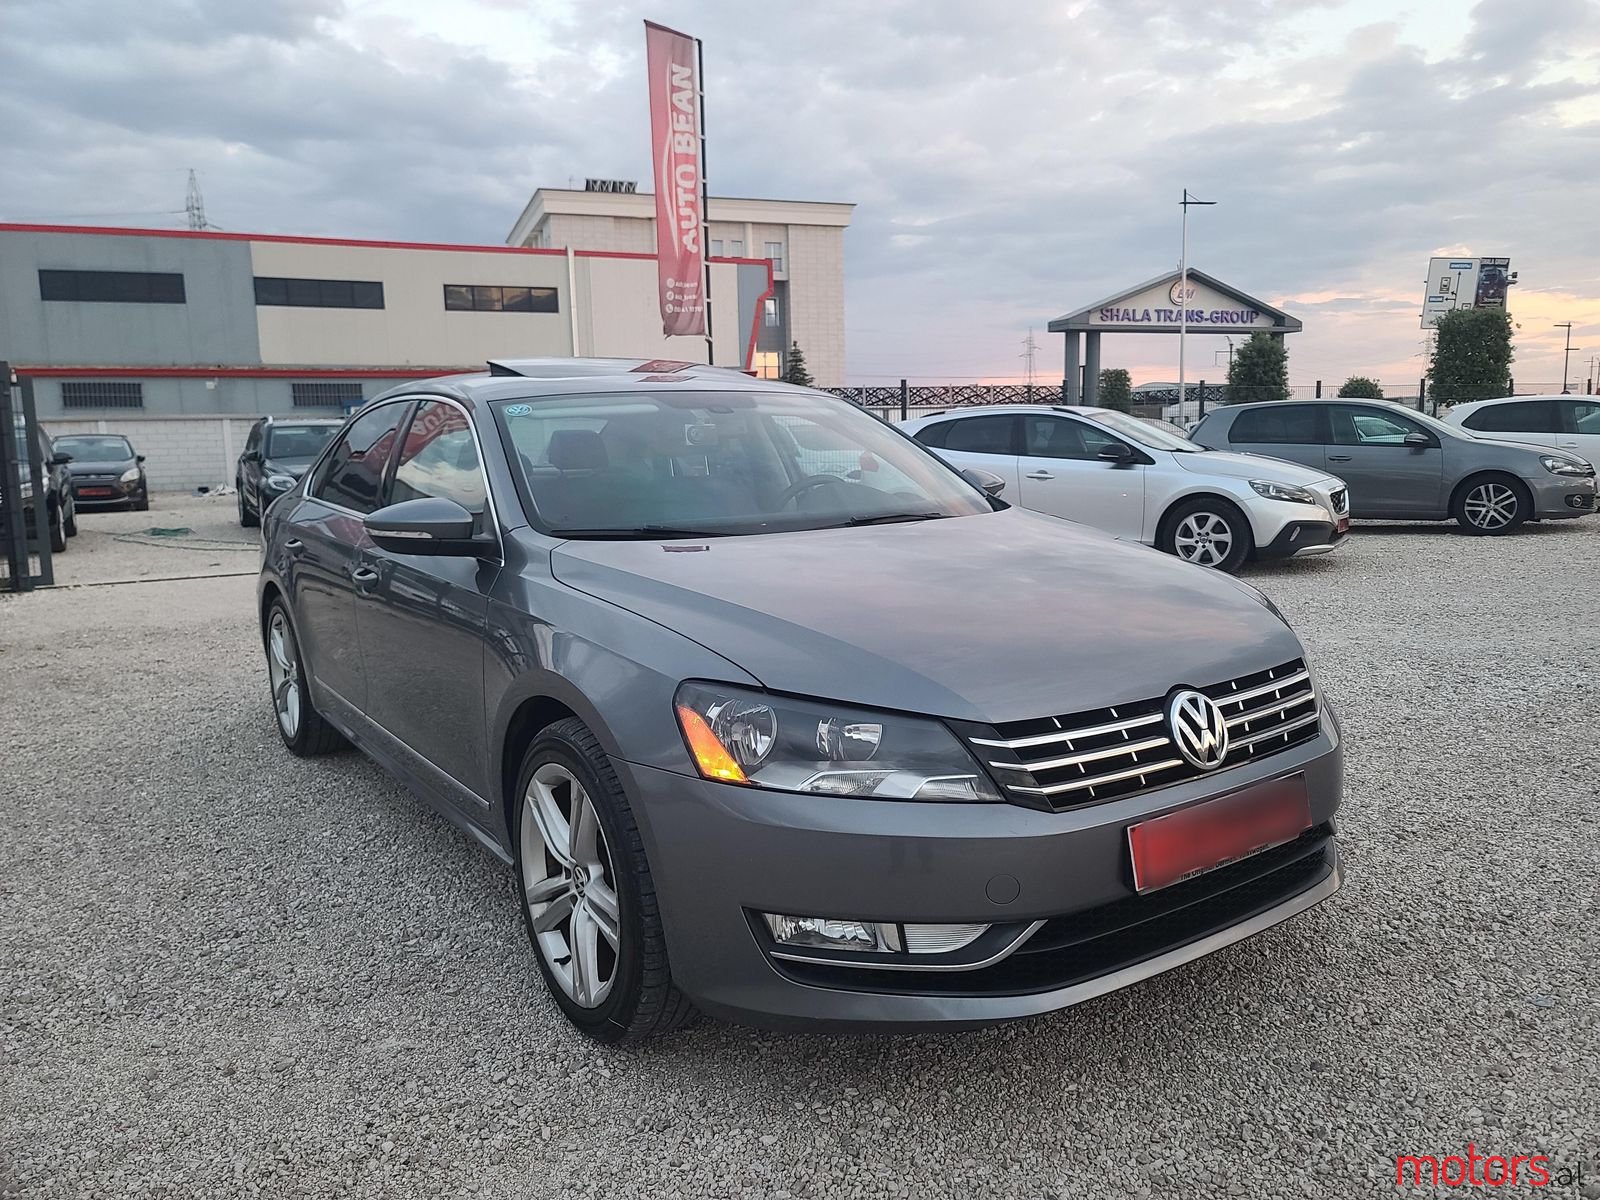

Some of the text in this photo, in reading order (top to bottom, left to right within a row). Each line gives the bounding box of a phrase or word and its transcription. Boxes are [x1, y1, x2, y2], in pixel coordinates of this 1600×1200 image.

[672, 63, 697, 155] BEAN
[676, 164, 699, 254] AUTO
[1100, 308, 1260, 324] SHALA TRANS-GROUP
